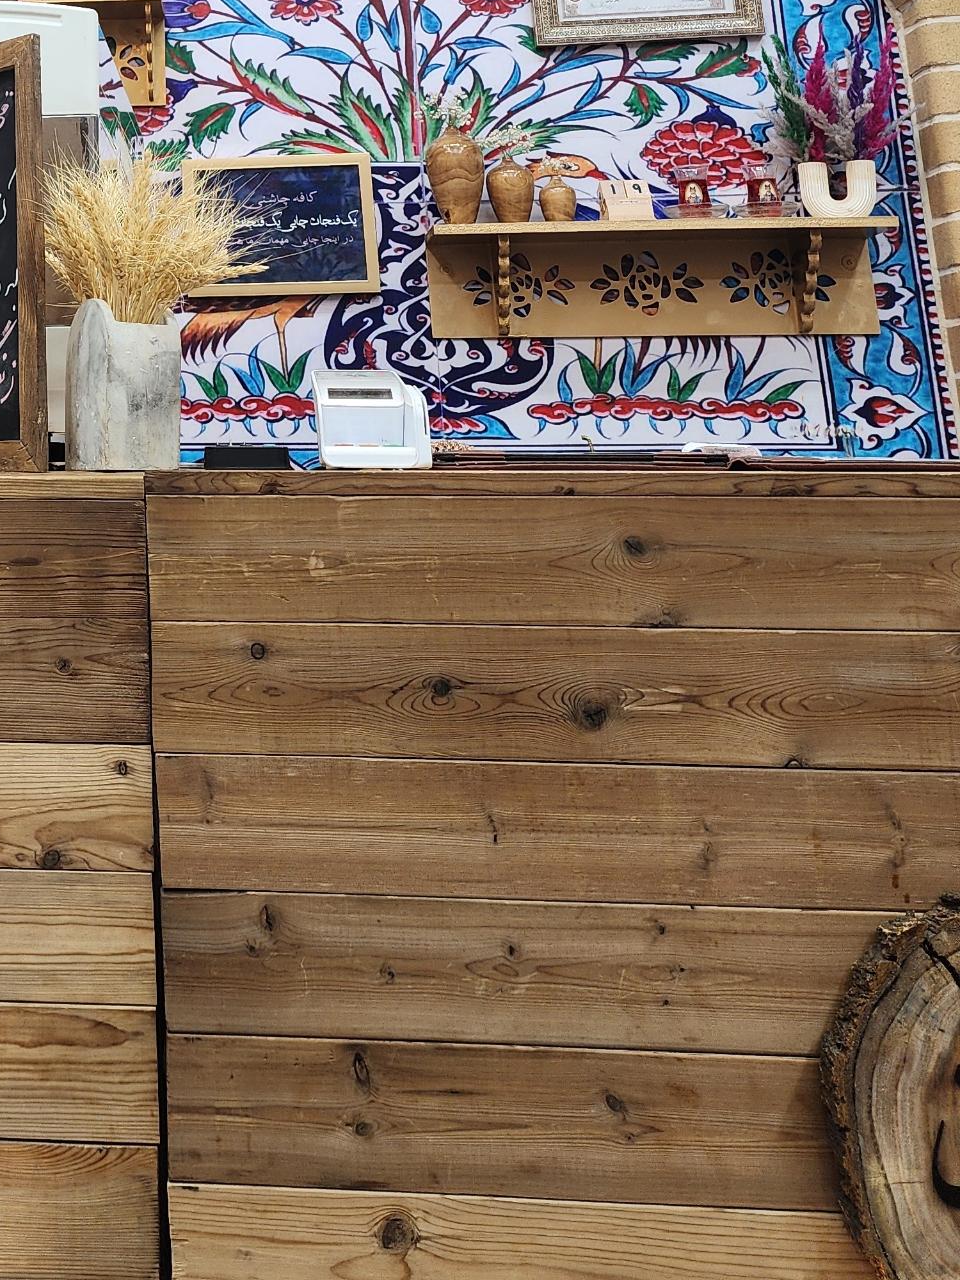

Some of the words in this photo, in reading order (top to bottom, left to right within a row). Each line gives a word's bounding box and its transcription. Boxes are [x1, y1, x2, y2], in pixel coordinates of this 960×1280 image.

[242, 193, 291, 209] چاشنی
[292, 190, 318, 203] کافه
[265, 211, 282, 228] یک
[310, 214, 342, 227] فنجان
[342, 209, 359, 227] یک
